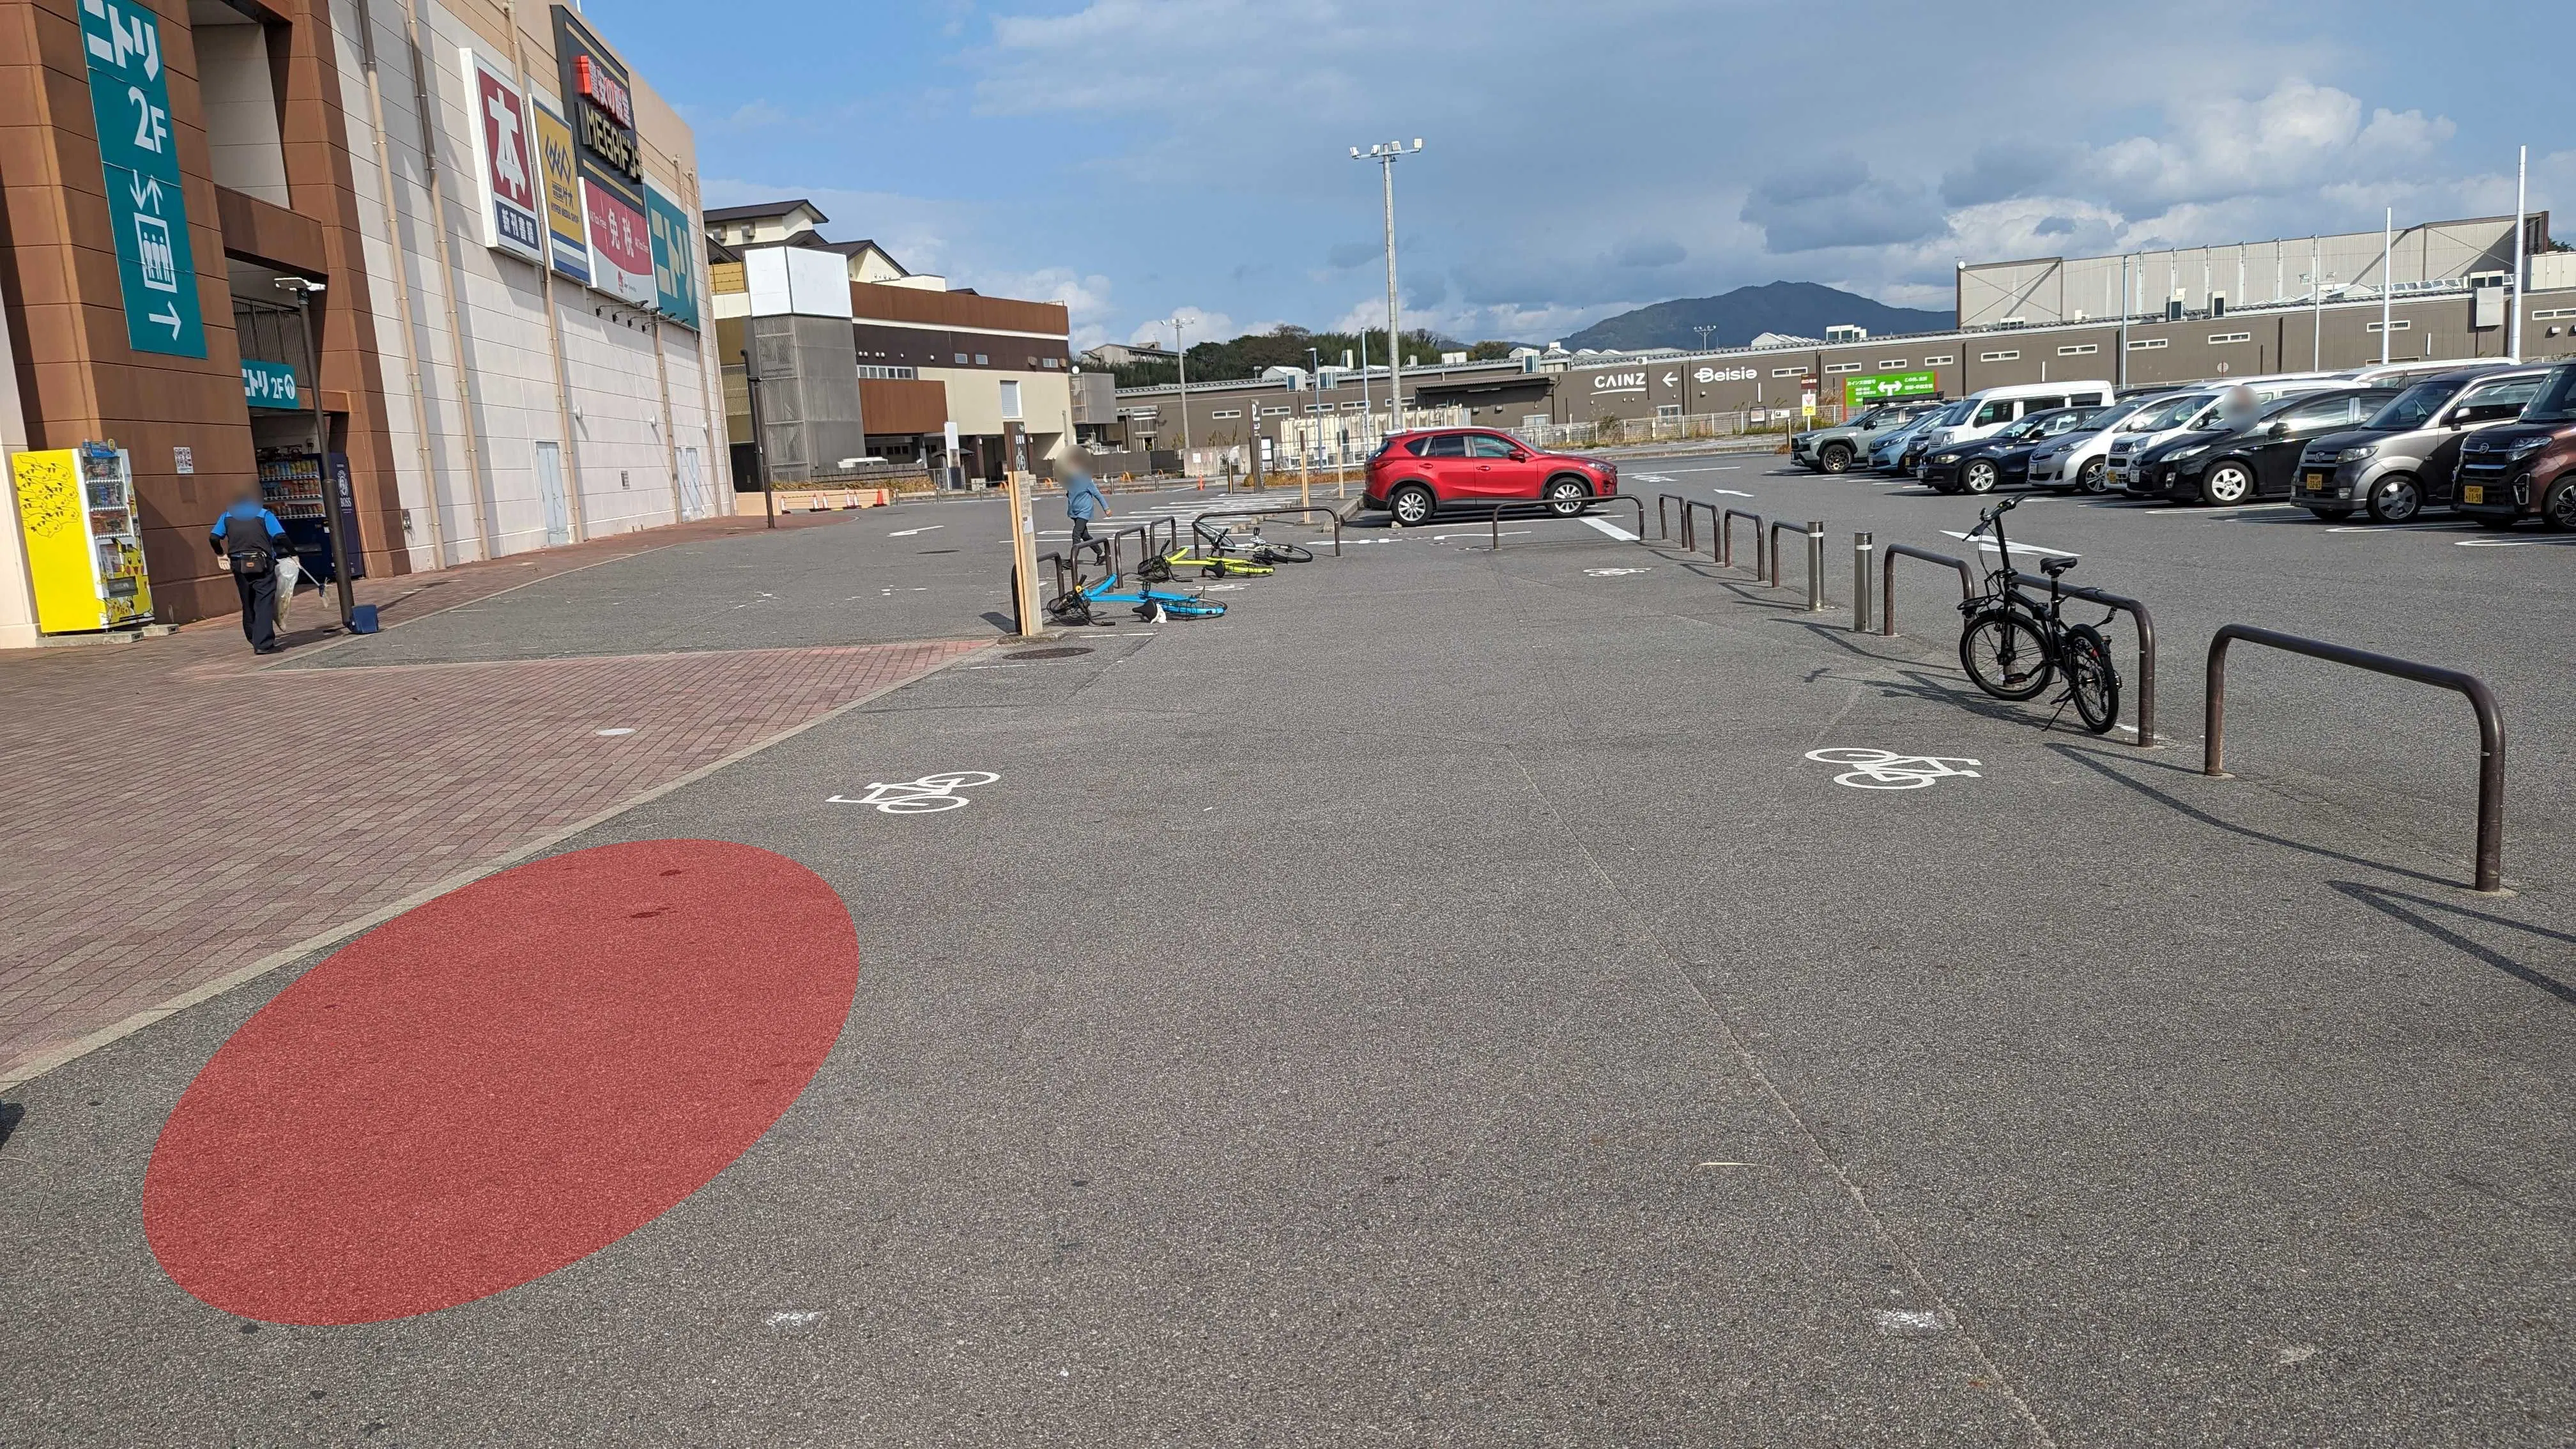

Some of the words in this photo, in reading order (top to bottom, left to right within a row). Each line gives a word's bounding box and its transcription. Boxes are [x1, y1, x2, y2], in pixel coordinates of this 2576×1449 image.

[128, 86, 167, 154] 2F
[487, 87, 526, 200] 本
[650, 208, 693, 307] ニトリ
[1594, 372, 1646, 388] CAINZ
[1694, 366, 1758, 383] Beisia
[270, 377, 284, 399] 2F
[340, 497, 352, 507] BOSS
